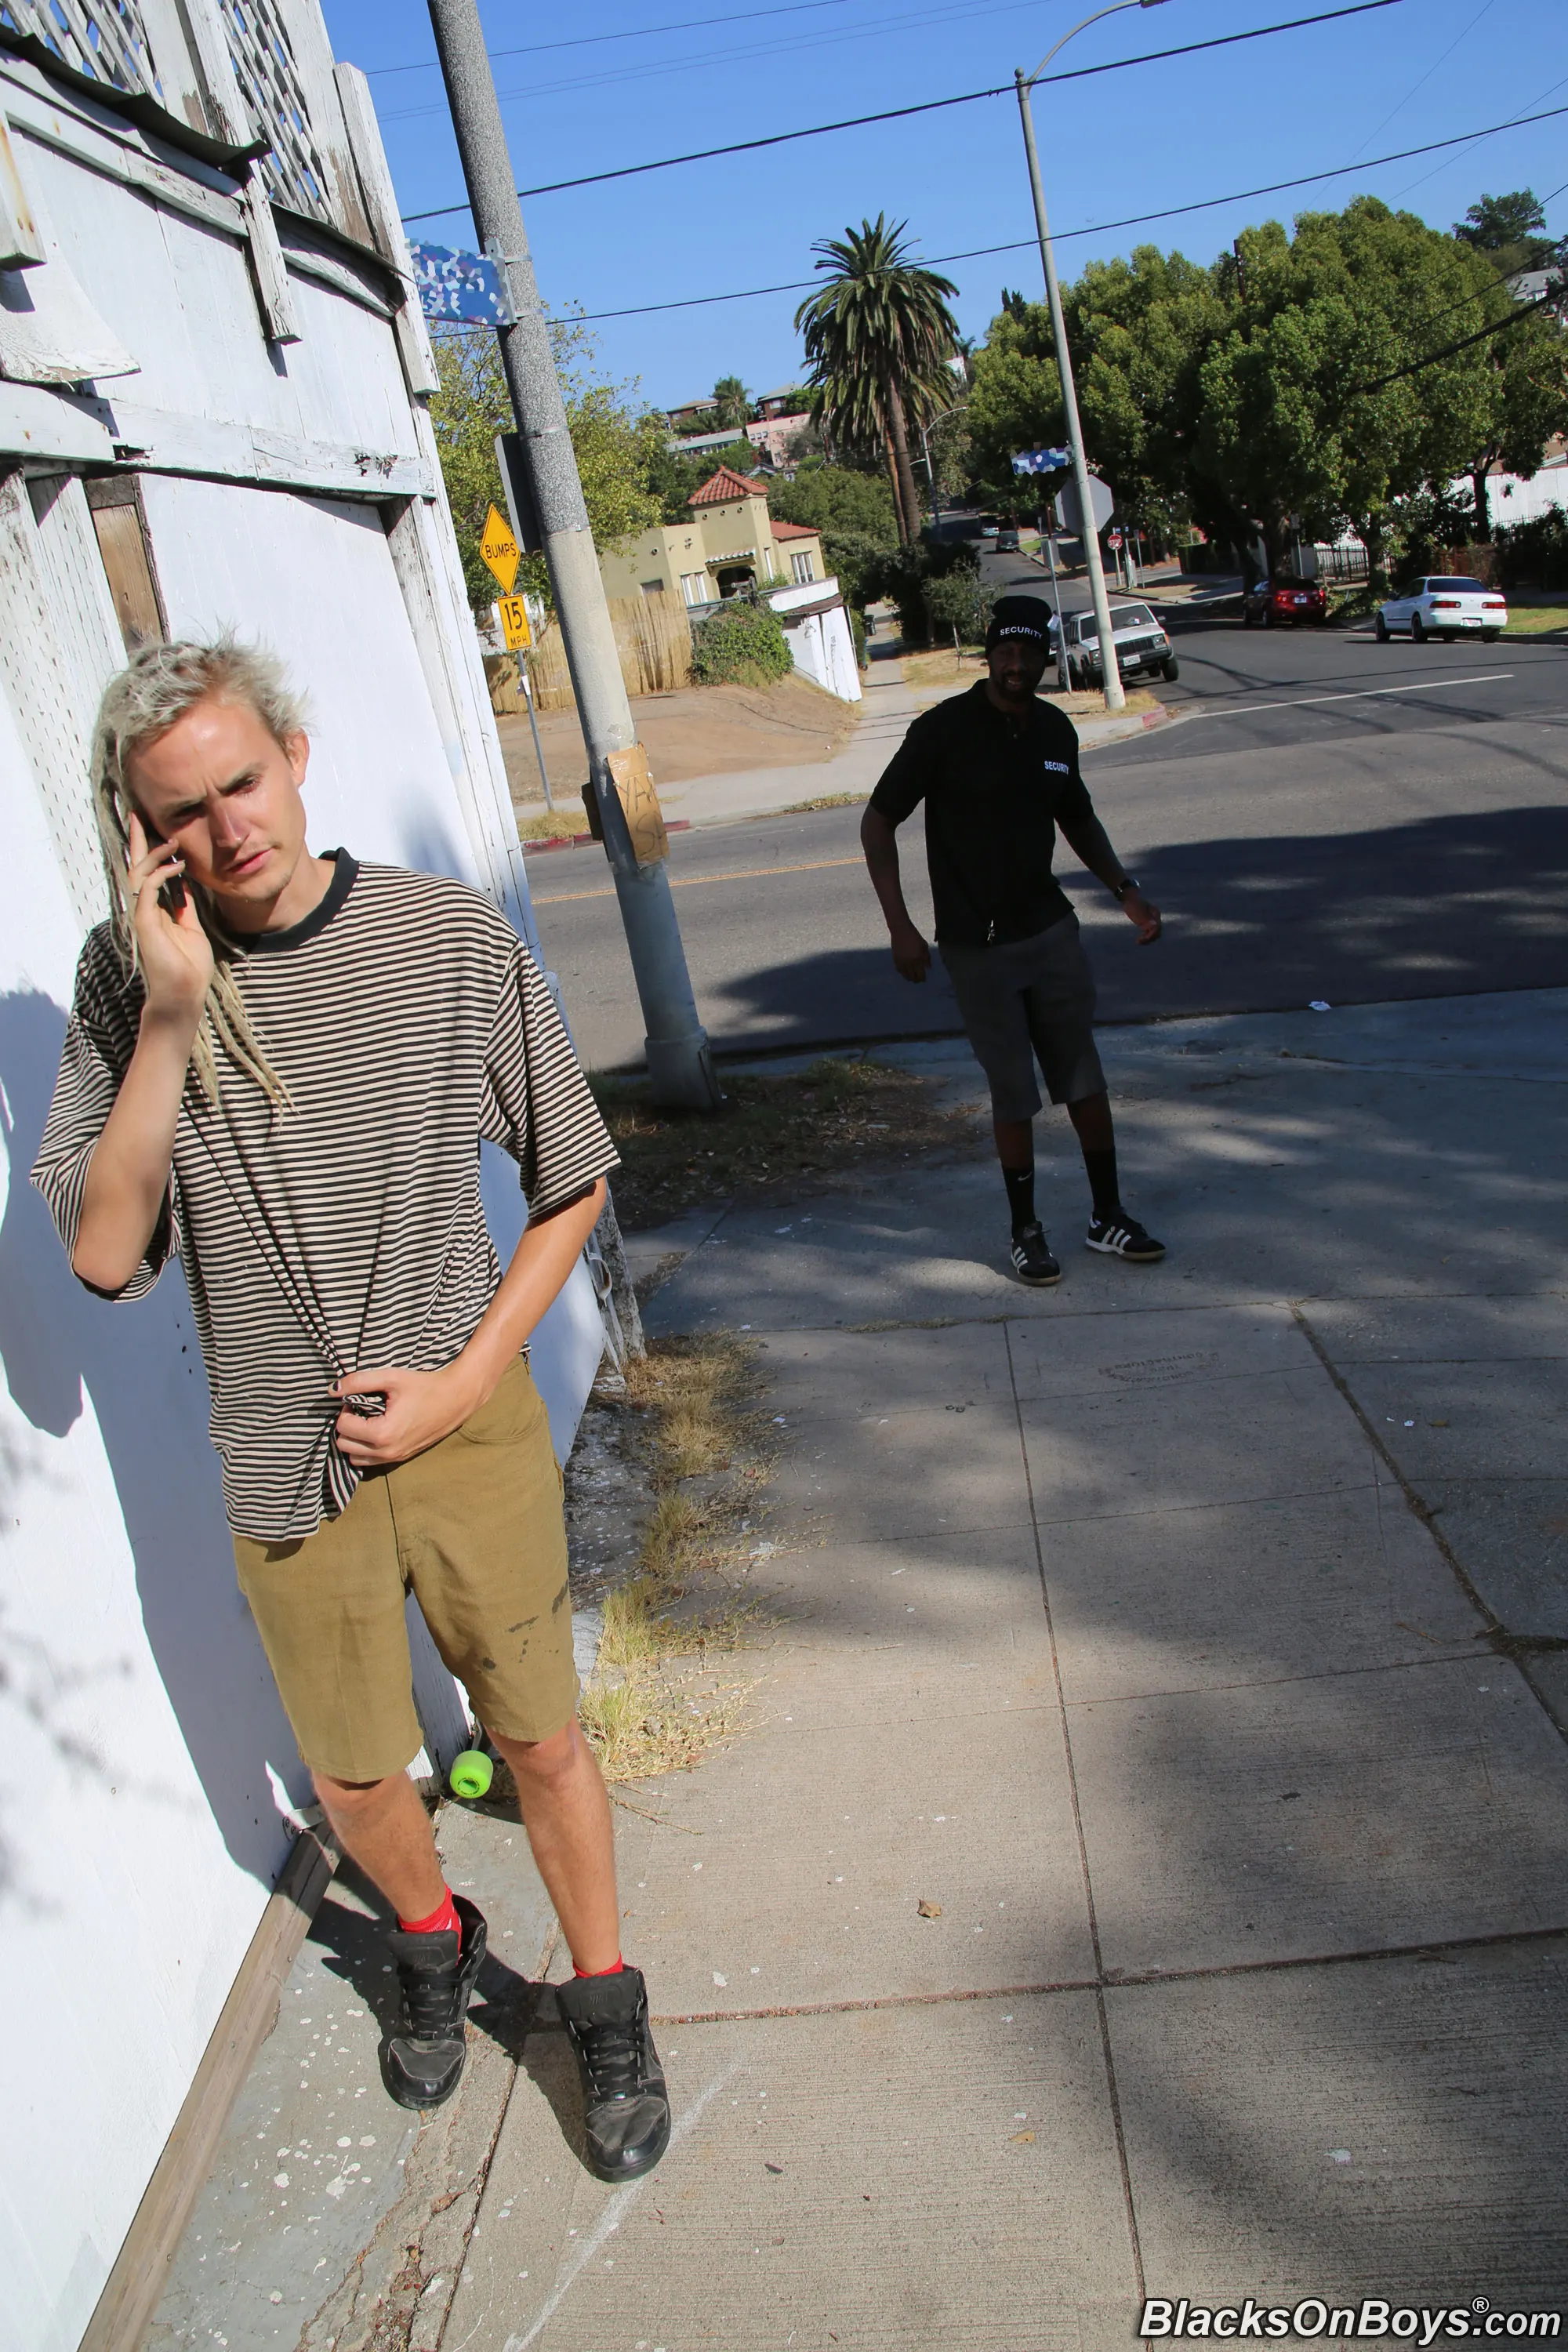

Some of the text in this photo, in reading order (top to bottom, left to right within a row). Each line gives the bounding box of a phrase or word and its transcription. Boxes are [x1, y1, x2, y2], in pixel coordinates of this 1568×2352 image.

[485, 543, 517, 559] BUMPS
[504, 601, 523, 631] 15
[1000, 626, 1043, 640] SECURITY
[510, 634, 528, 648] MPH
